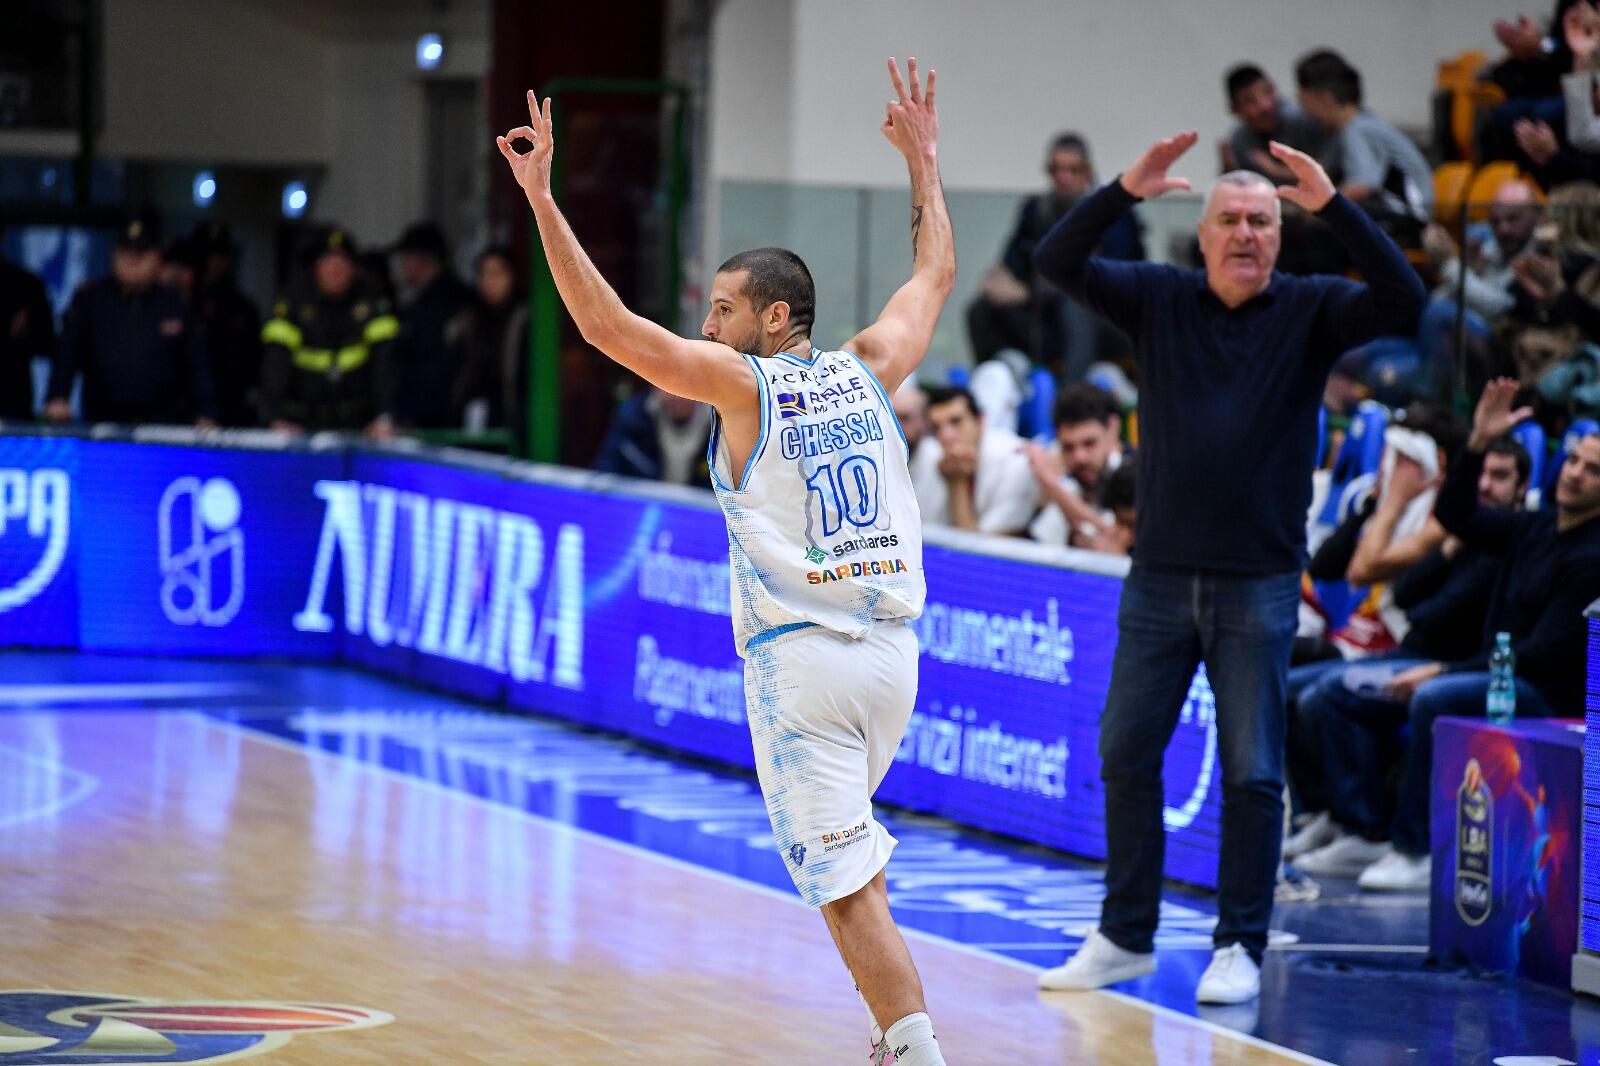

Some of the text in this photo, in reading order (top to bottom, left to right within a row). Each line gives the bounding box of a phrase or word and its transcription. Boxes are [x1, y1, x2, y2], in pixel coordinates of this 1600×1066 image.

[780, 409, 884, 460] CHESSA
[806, 454, 879, 537] 10
[832, 534, 899, 557] sardares
[292, 479, 584, 690] NUMERA
[806, 558, 908, 585] SARDEGNA
